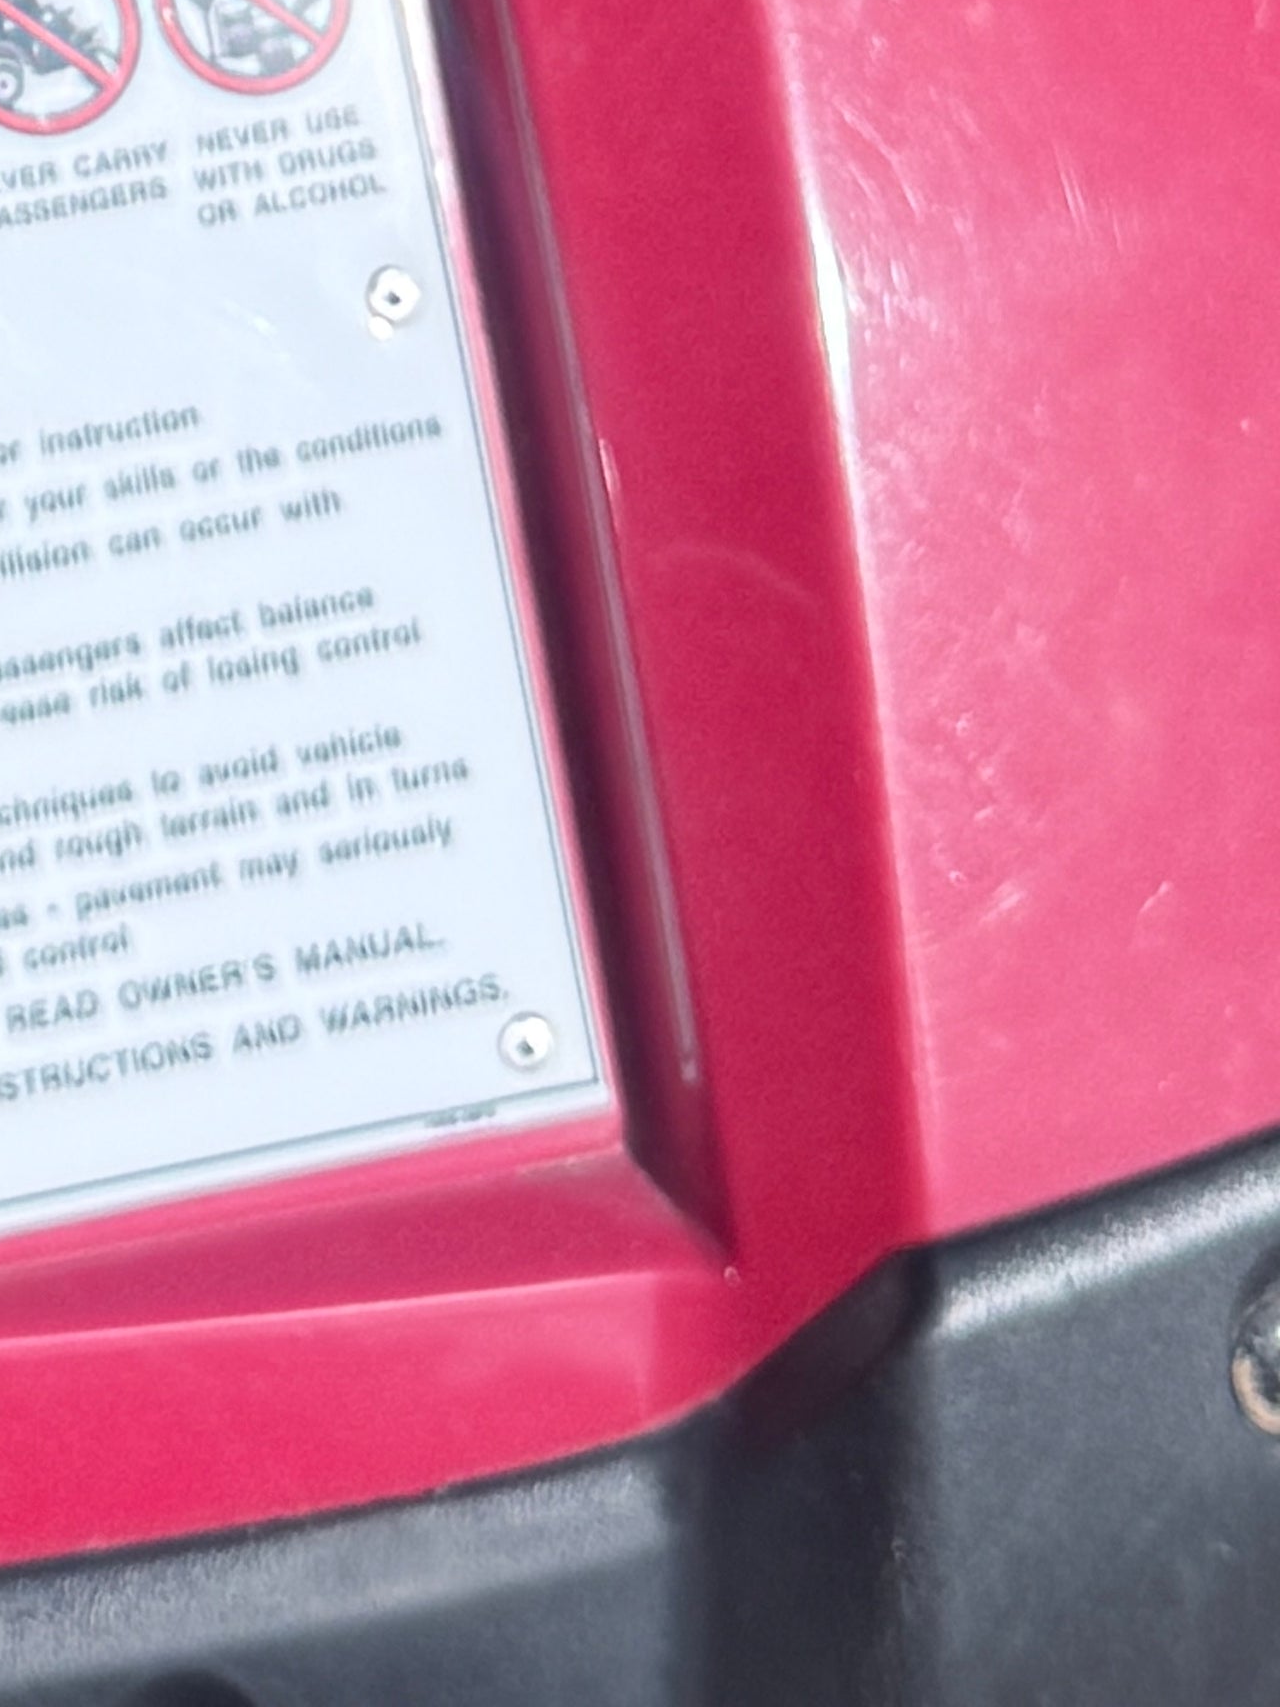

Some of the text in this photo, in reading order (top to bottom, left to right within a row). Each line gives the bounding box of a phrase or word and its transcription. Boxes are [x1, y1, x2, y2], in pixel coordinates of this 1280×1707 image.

[72, 140, 167, 178] CARRY
[195, 104, 360, 153] NEVER USE
[192, 137, 377, 192] WITH DRUGS
[196, 173, 386, 228] OR ALCOHOL
[39, 406, 199, 455] instruction
[23, 483, 86, 524] your
[103, 464, 177, 501] skills
[191, 457, 220, 484] or
[235, 446, 281, 475] the
[295, 416, 442, 463] conditions
[107, 525, 162, 557] can
[178, 505, 262, 543] occur
[279, 488, 342, 522] with
[159, 609, 243, 649] affect
[257, 587, 374, 629] balance
[88, 672, 145, 708] risk
[160, 660, 191, 694] of
[206, 645, 301, 684] losing
[316, 618, 421, 663] control
[149, 769, 181, 796] to
[198, 745, 279, 787] avoid
[295, 725, 402, 765] vehicle
[54, 820, 143, 860] rough
[159, 799, 259, 838] terrain
[275, 779, 331, 817] and
[345, 773, 379, 804] in
[390, 757, 469, 793] turns
[74, 861, 222, 921] pavement
[238, 849, 299, 881] may
[318, 817, 452, 865] seriously
[5, 989, 99, 1032] READ
[294, 923, 443, 974] MANUAL.
[22, 923, 128, 971] control
[232, 1013, 302, 1053] AND
[320, 973, 508, 1033] WARNINGS.
